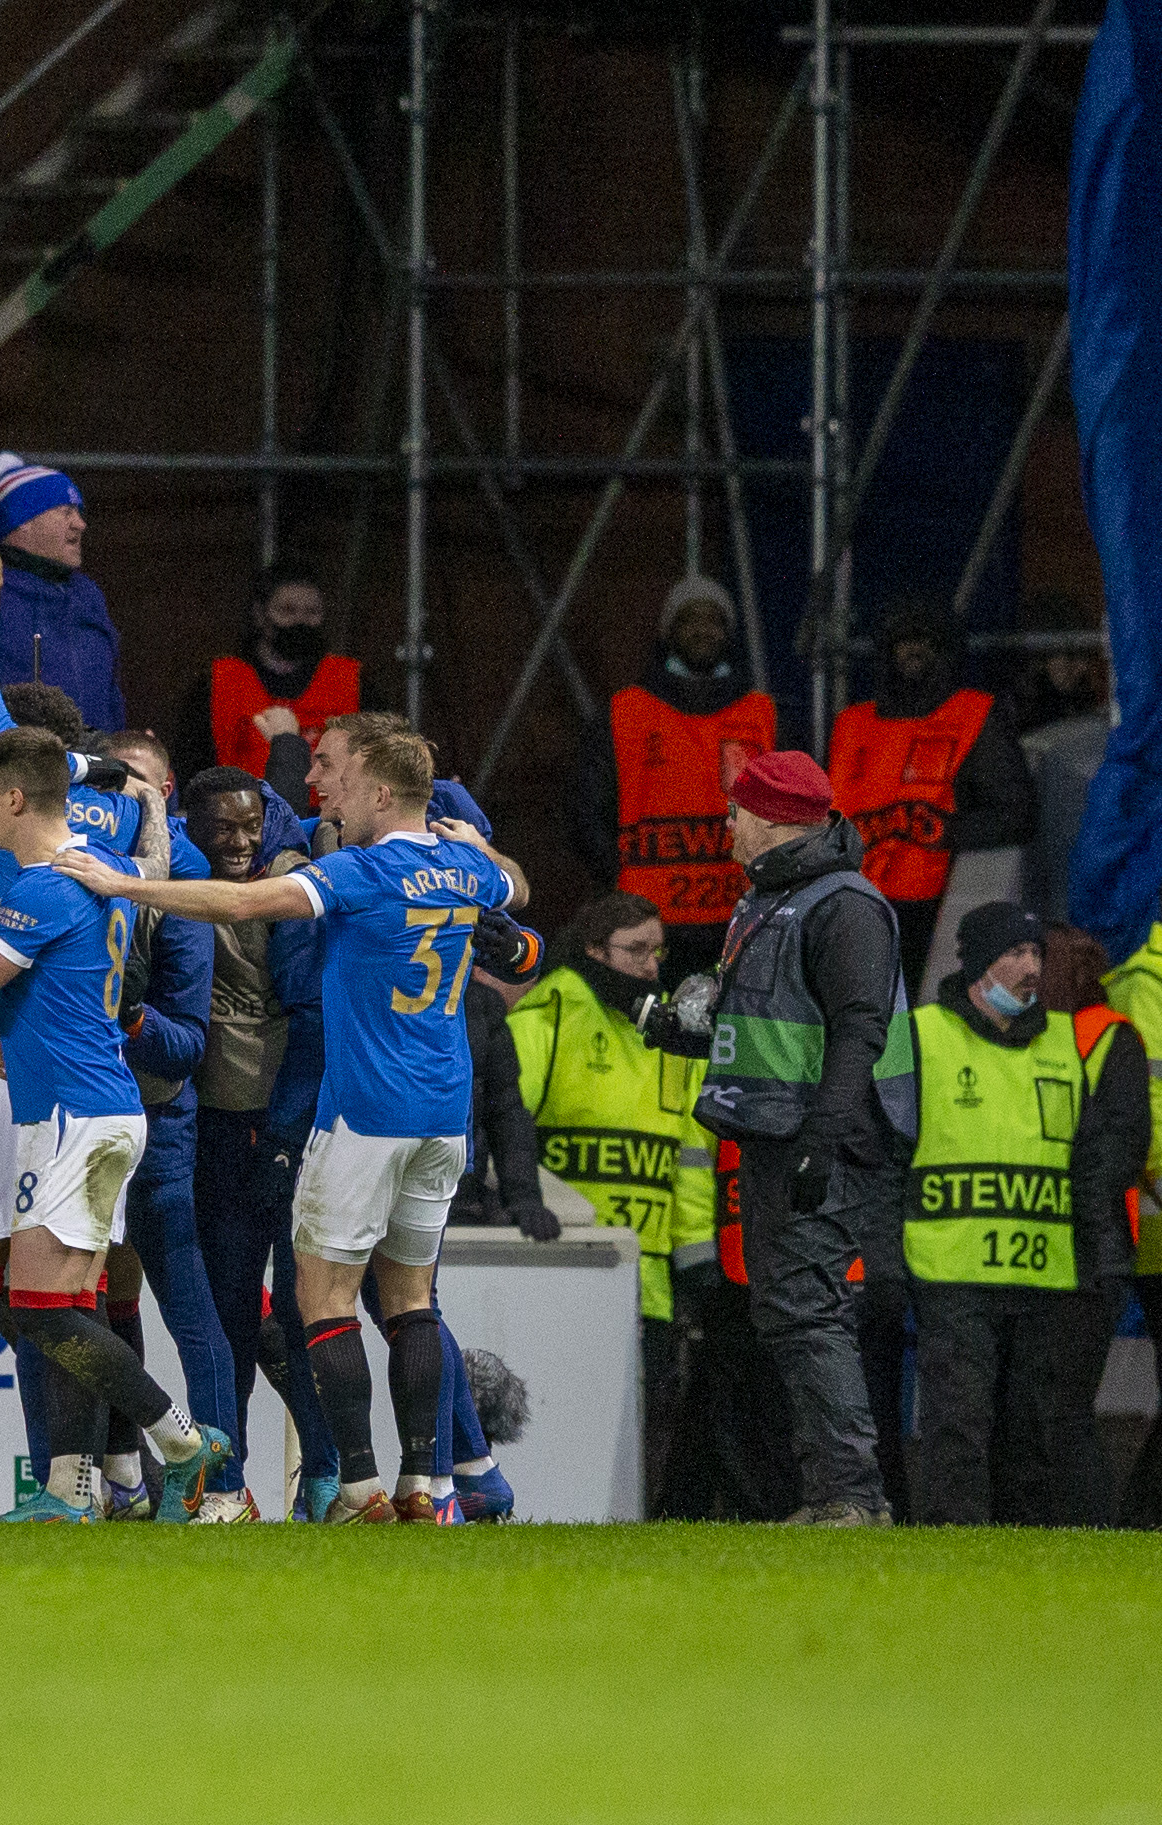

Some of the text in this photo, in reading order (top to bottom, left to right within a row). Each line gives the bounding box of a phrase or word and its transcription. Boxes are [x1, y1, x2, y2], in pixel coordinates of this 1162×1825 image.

[103, 908, 127, 1020] 8
[391, 907, 480, 1016] 37
[15, 1171, 39, 1214] 8
[981, 1229, 1049, 1271] 128
